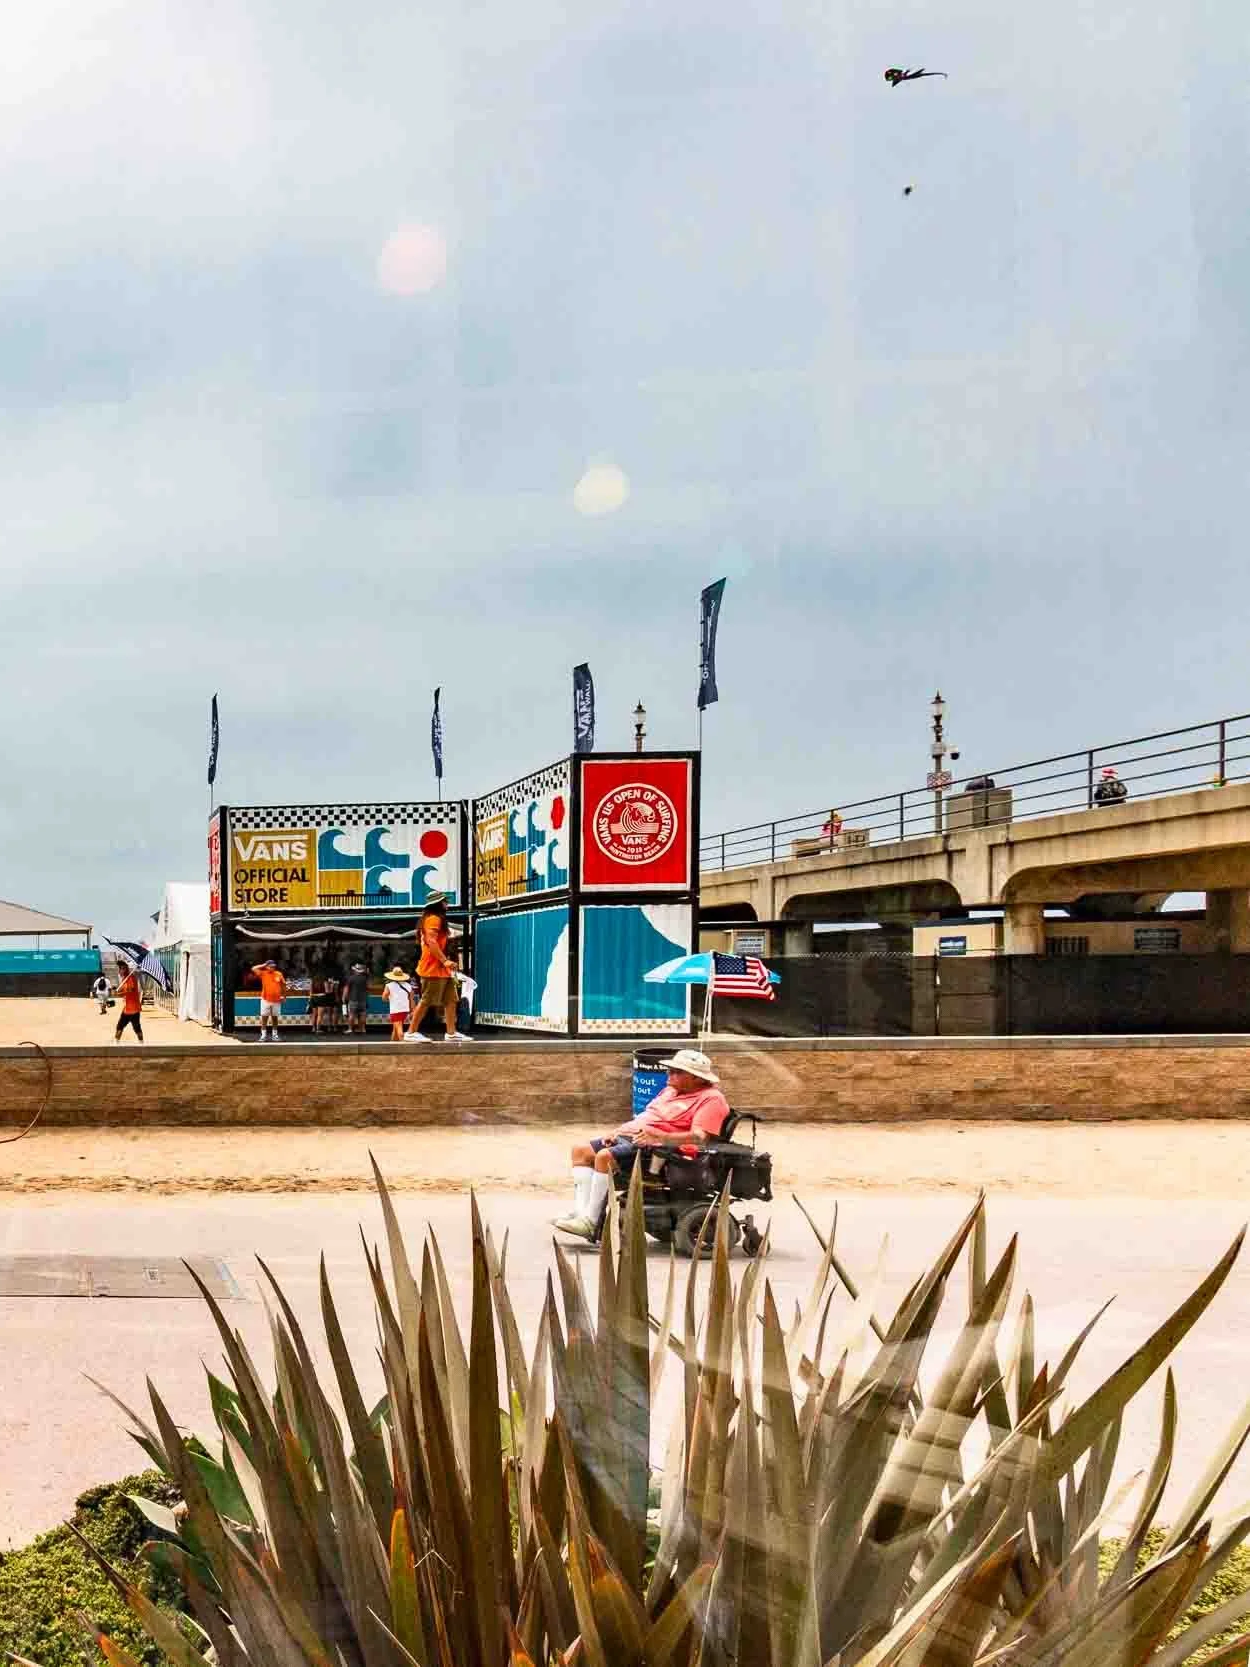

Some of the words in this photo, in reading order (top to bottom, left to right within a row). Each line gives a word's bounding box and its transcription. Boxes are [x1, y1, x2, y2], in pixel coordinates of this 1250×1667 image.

[613, 789, 641, 804] OPEN
[643, 791, 658, 802] OF
[602, 802, 615, 816] US
[655, 800, 672, 843] SURFING
[598, 817, 612, 844] VANS
[621, 834, 650, 845] VANS
[234, 835, 309, 861] VANS
[234, 868, 310, 884] OFFICIAL
[235, 888, 288, 904] STORE
